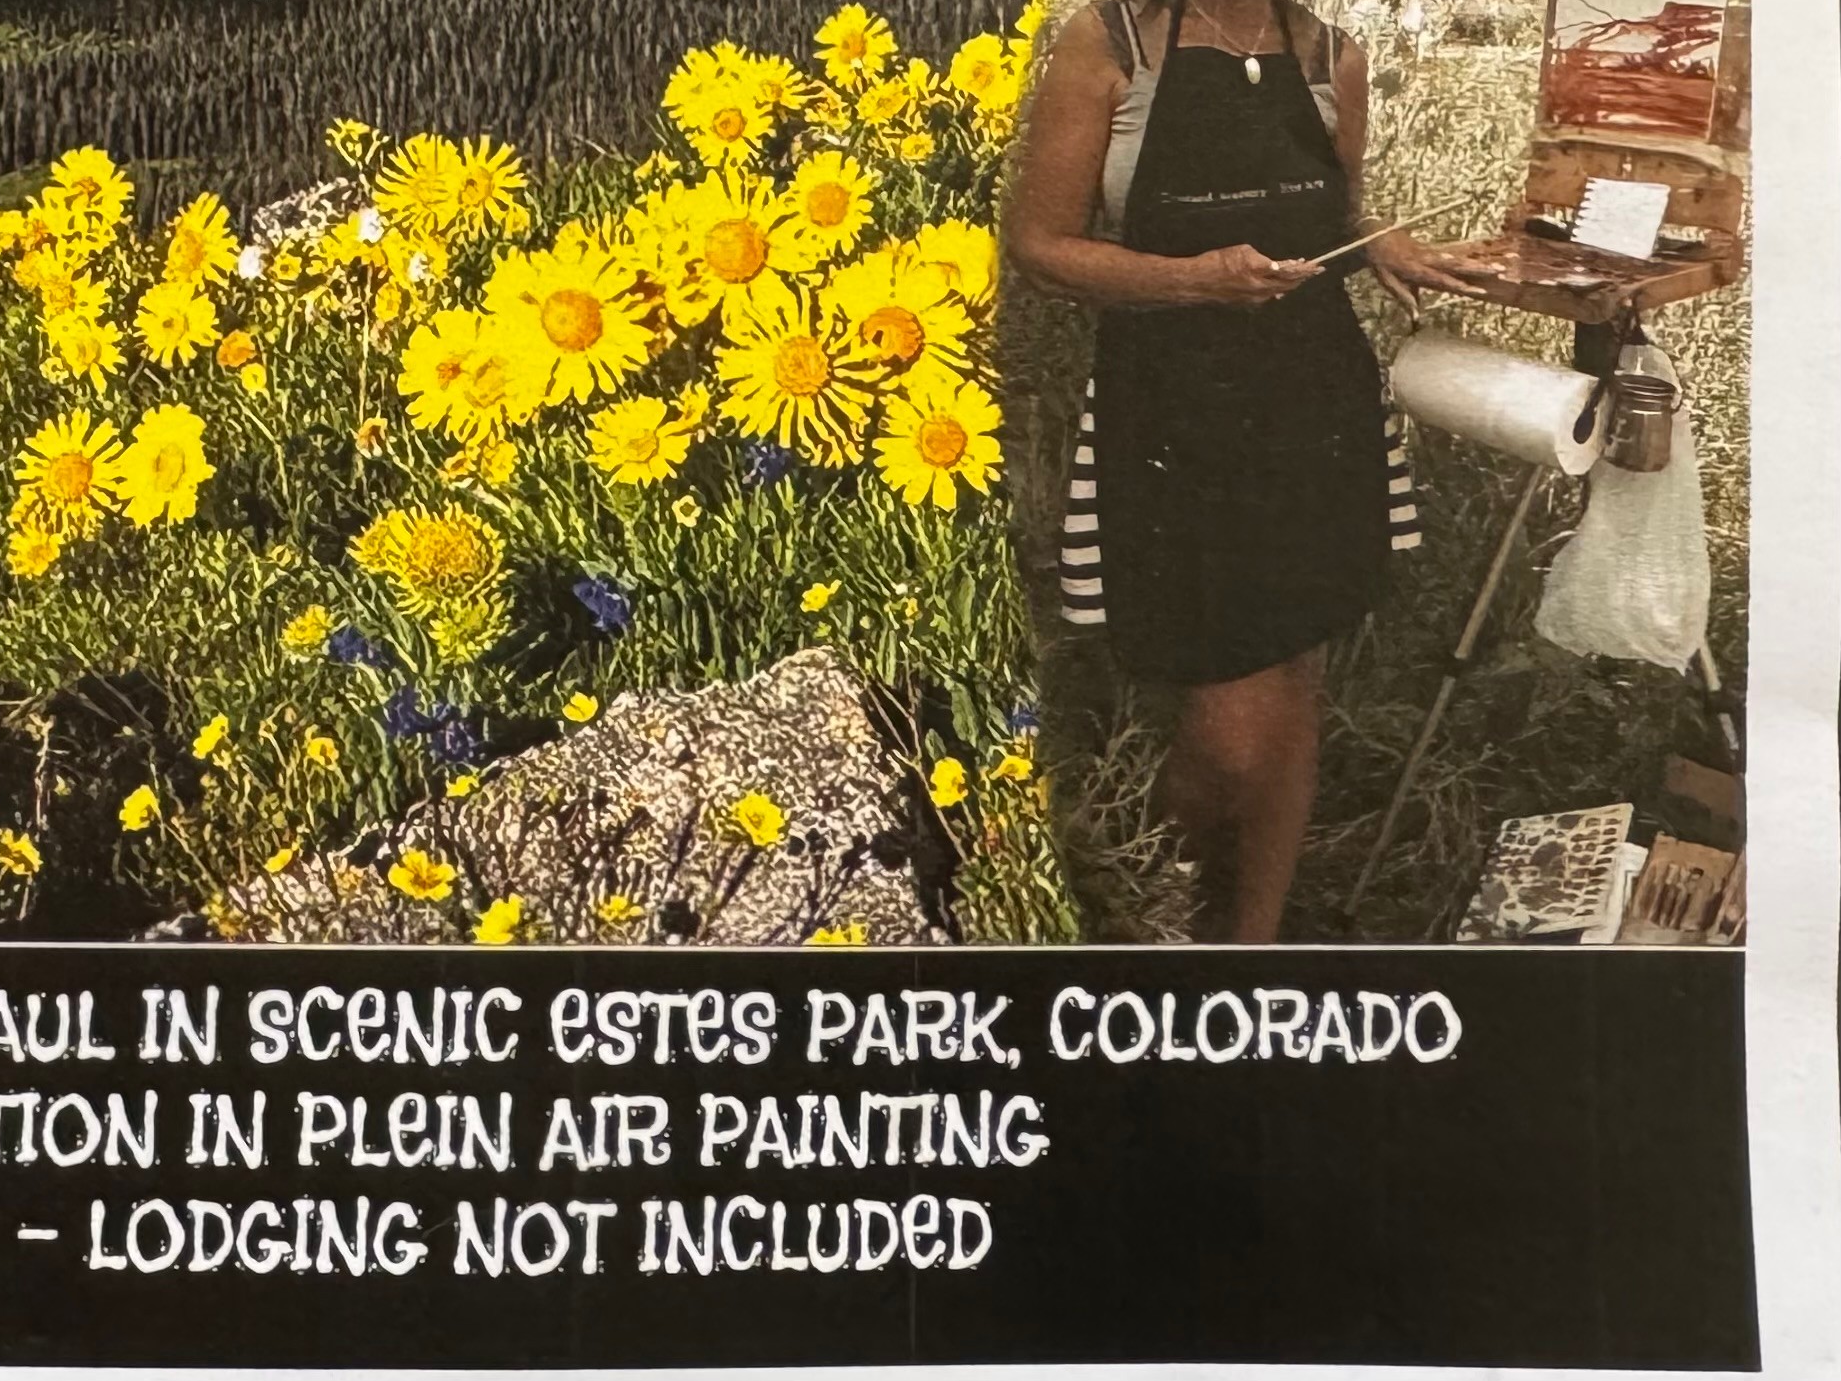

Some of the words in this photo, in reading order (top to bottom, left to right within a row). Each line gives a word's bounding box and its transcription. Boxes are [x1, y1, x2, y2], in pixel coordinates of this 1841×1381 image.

[140, 986, 219, 1064] IN
[807, 989, 1020, 1068] PARK,
[1050, 987, 1461, 1063] COLORADO
[187, 1091, 265, 1169] IN
[539, 1094, 670, 1171] AIR
[700, 1090, 1049, 1168] PAINTING
[90, 1196, 428, 1276] LODGING
[454, 1198, 617, 1277] NOT
